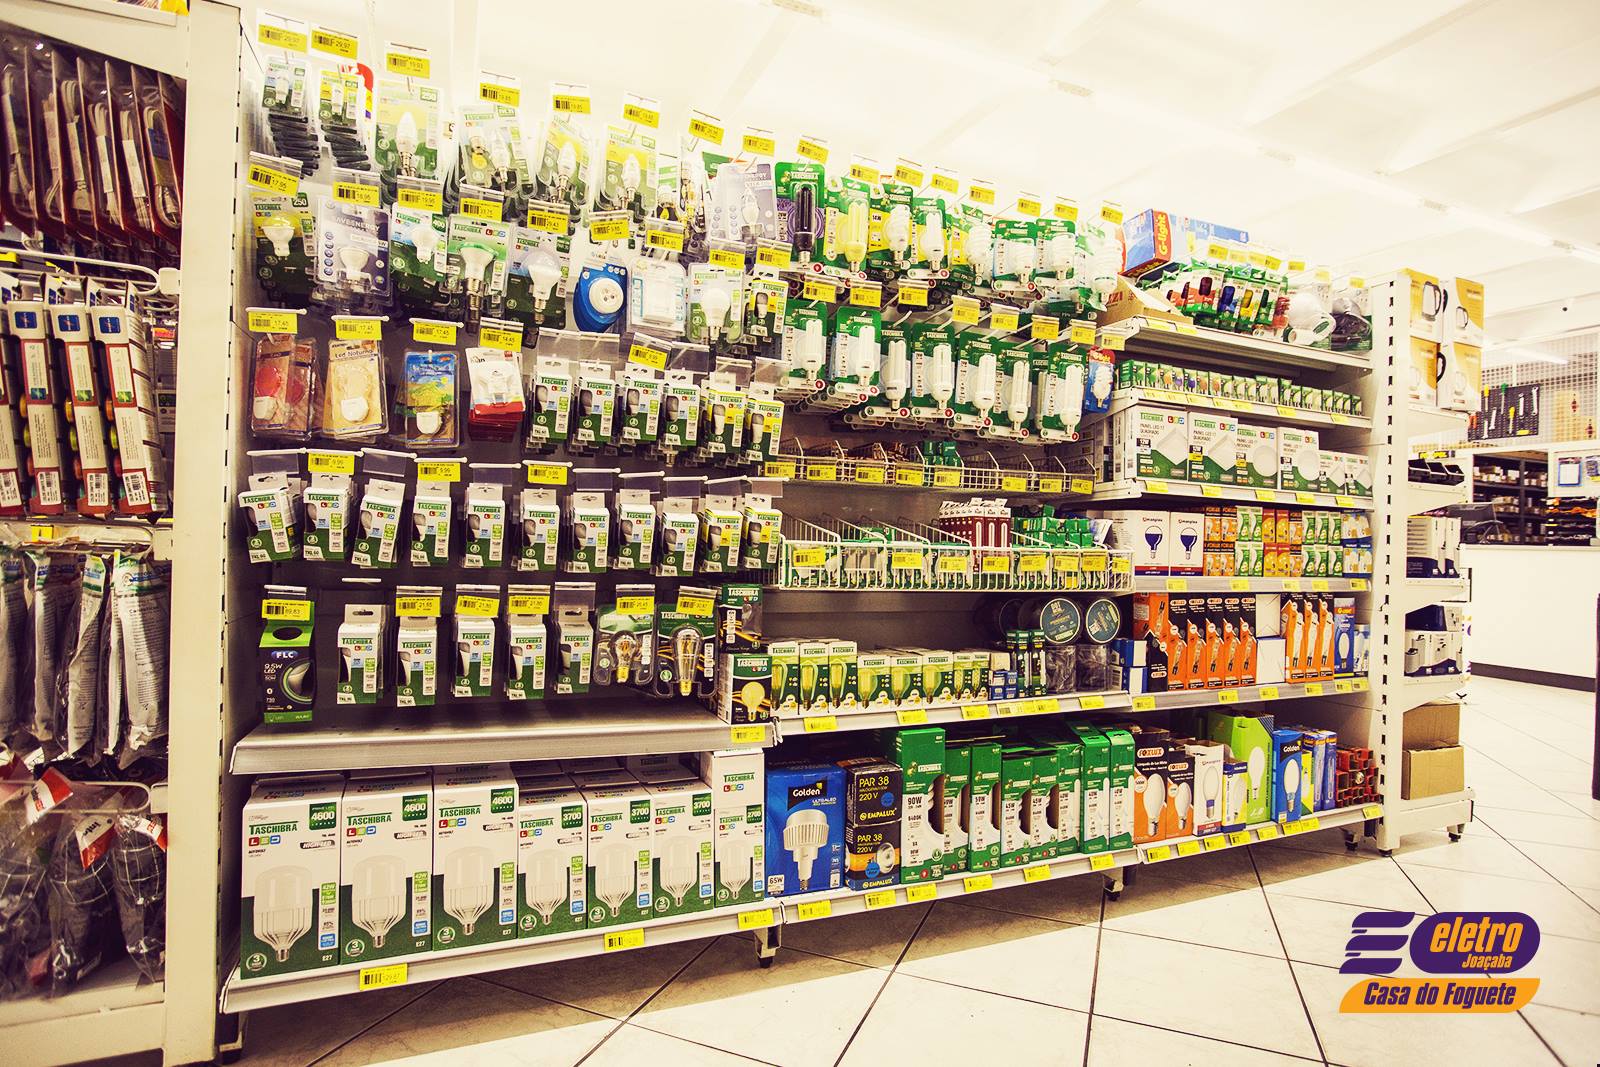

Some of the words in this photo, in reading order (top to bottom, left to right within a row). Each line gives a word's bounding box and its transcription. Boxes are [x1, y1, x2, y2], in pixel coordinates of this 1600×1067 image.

[294, 198, 307, 206] 250
[728, 588, 758, 597] TASCHIBRA
[737, 658, 768, 667] TASCHIBRA
[1283, 745, 1300, 753] Golden
[723, 772, 755, 781] TASCHIBRA
[859, 777, 877, 787] PAR
[878, 776, 889, 785] 38
[793, 788, 820, 797] Golden
[492, 796, 513, 806] 4600
[859, 794, 873, 802] 220
[907, 796, 922, 806] 90W
[403, 802, 427, 813] 4600
[693, 801, 711, 809] 3700
[311, 810, 336, 821] 4600
[439, 804, 482, 818] TASCHIBRA
[631, 808, 650, 816] 3700
[655, 805, 686, 816] TASCHIBRA
[867, 810, 895, 820] EMPALUX
[346, 812, 392, 826] TASCHIBRA
[563, 811, 582, 821] 3700
[591, 812, 623, 823] TASCHIBRA
[249, 820, 298, 836] TASCHIBRA
[520, 818, 554, 829] TASCHIBRA
[857, 834, 873, 842] PAR
[874, 833, 883, 841] 38
[857, 846, 869, 854] 220
